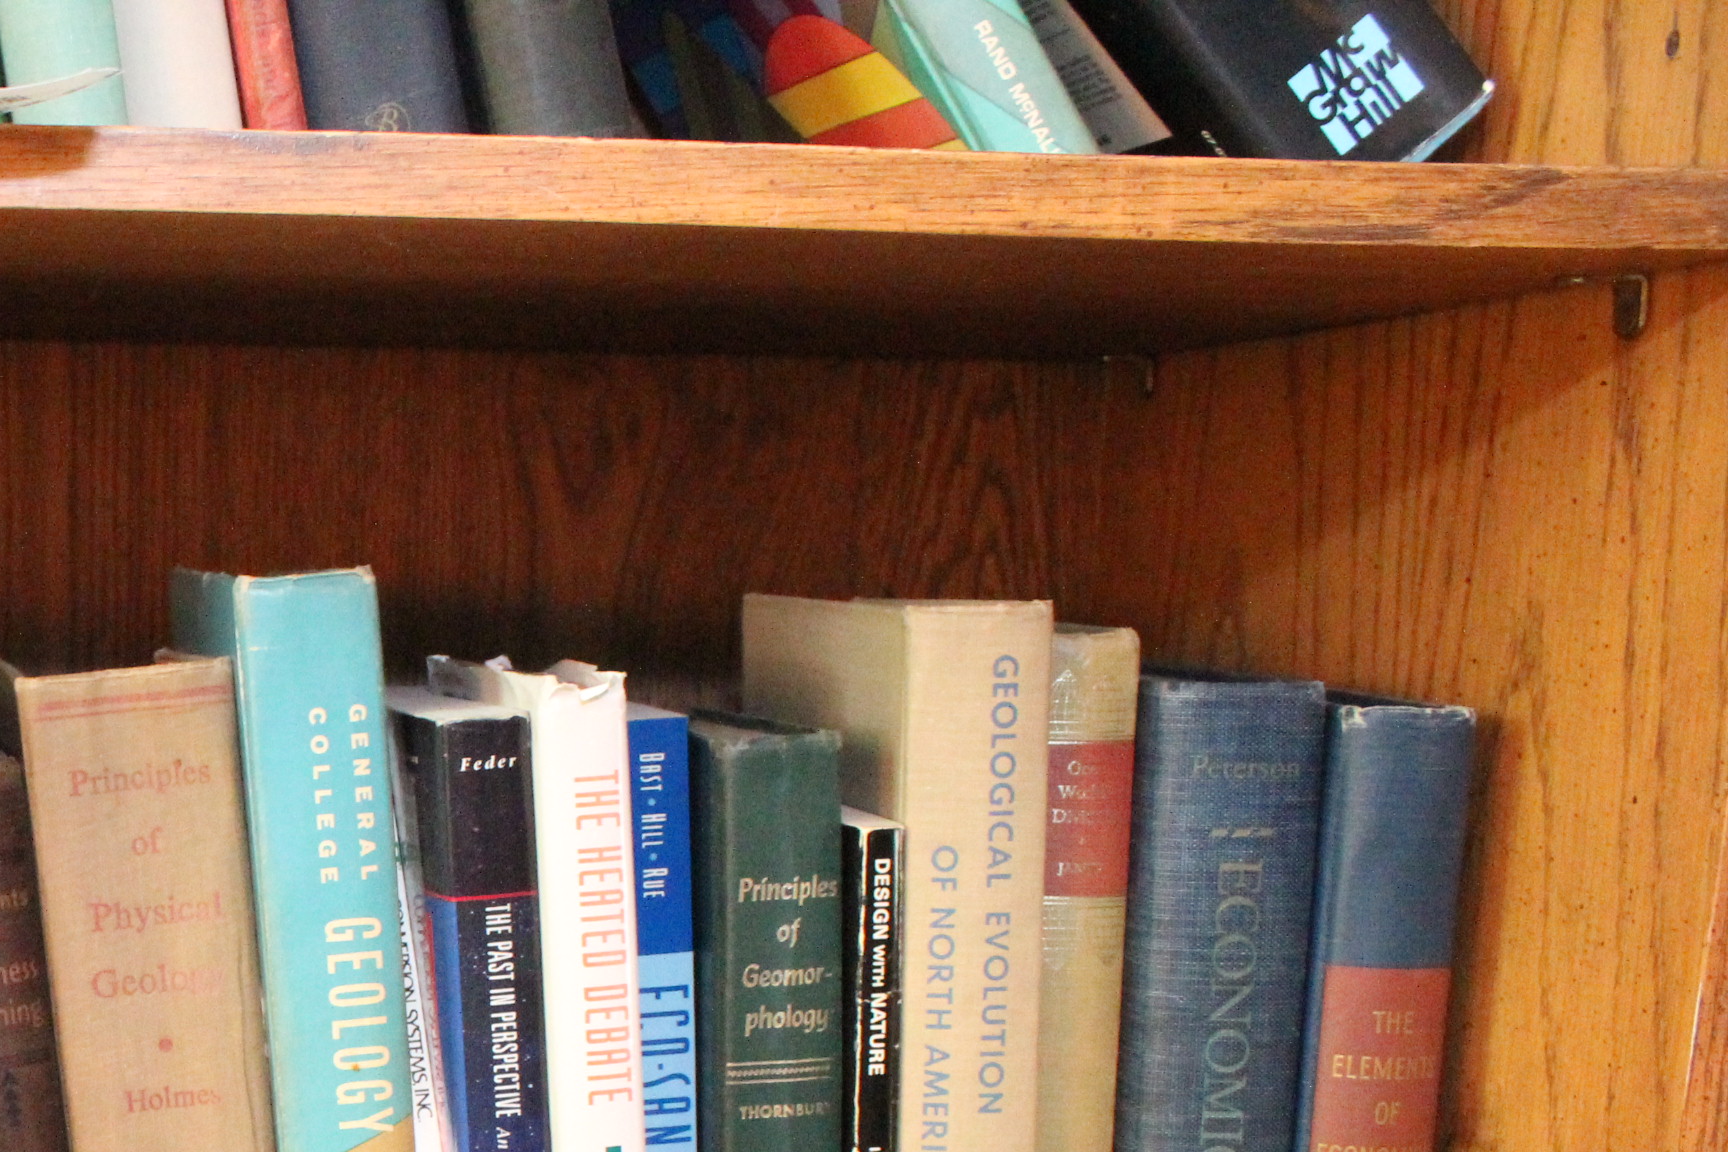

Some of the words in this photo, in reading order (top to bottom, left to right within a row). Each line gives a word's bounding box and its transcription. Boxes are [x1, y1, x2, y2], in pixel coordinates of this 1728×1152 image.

[974, 20, 1017, 80] RAND
[68, 758, 212, 798] Principles
[460, 754, 517, 772] Feder
[987, 653, 1020, 888] GEOLOGICAL
[1192, 755, 1300, 780] Peterson
[308, 707, 340, 884] COLLEGE
[348, 703, 380, 881] GENERAL
[574, 769, 622, 831] THE
[131, 827, 162, 856] of
[738, 874, 839, 905] Principles
[930, 845, 959, 892] OF
[89, 891, 222, 933] Physical
[485, 903, 511, 935] THE
[577, 846, 627, 968] HEATED
[872, 857, 892, 940] DESIGN
[776, 917, 802, 948] of
[487, 939, 514, 981] PAST
[742, 963, 833, 989] Geomor-
[872, 944, 887, 987] WITH
[924, 908, 956, 1031] NORTH
[489, 987, 515, 1006] IN
[977, 912, 1011, 1115] EVOLUTION
[324, 916, 394, 1132] GEOLOGY
[744, 1005, 830, 1037] phology
[867, 991, 887, 1077] NATURE
[1372, 1011, 1414, 1034] THE
[490, 1011, 522, 1119] PERSPECTIVE
[583, 983, 633, 1106] DEBATE
[125, 1085, 221, 1114] Holmes
[1375, 1101, 1401, 1125] OF
[496, 1126, 513, 1152] An
